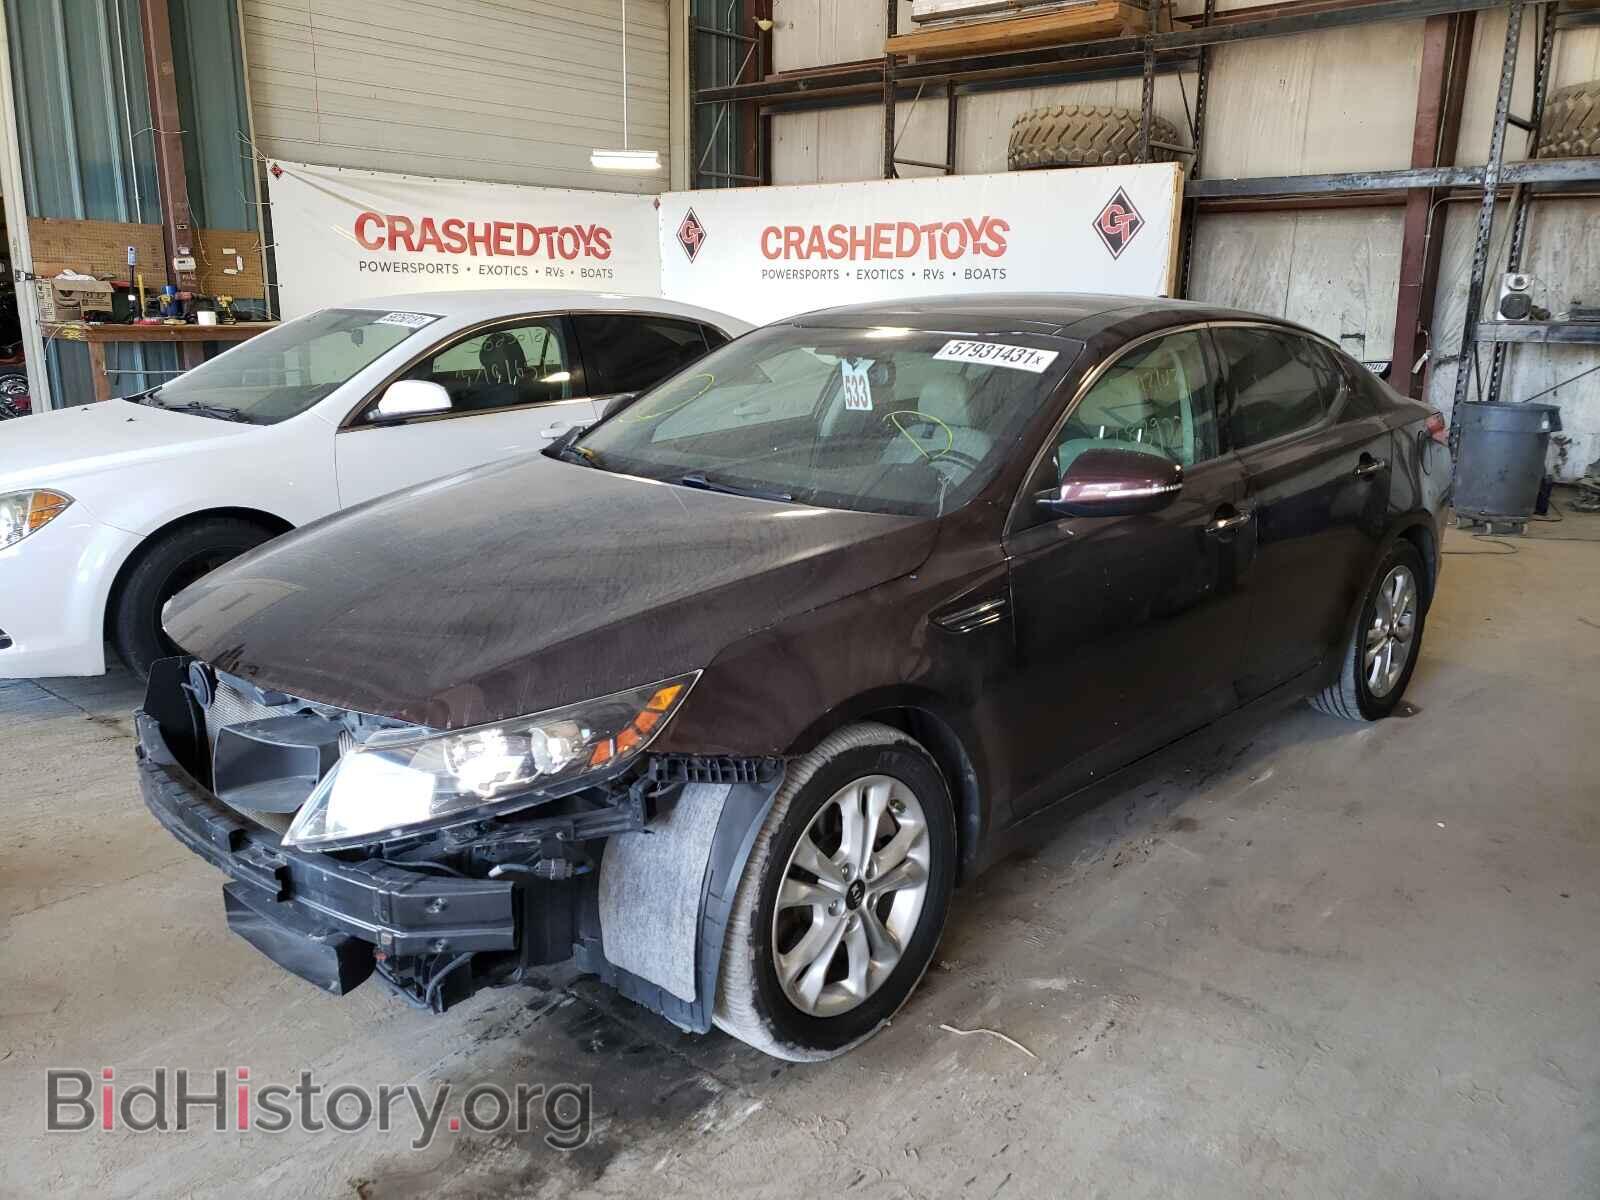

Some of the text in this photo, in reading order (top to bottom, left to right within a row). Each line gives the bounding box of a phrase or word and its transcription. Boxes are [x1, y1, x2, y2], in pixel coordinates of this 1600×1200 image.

[354, 211, 613, 261] CRASHEDTOYS
[761, 215, 1010, 260] CRASHEDTOYS
[359, 260, 613, 279] POWERSPORTS EXOTICS RVs BOATS
[761, 268, 1007, 280] POWERSPORTS EXOTICS RVs BOATS
